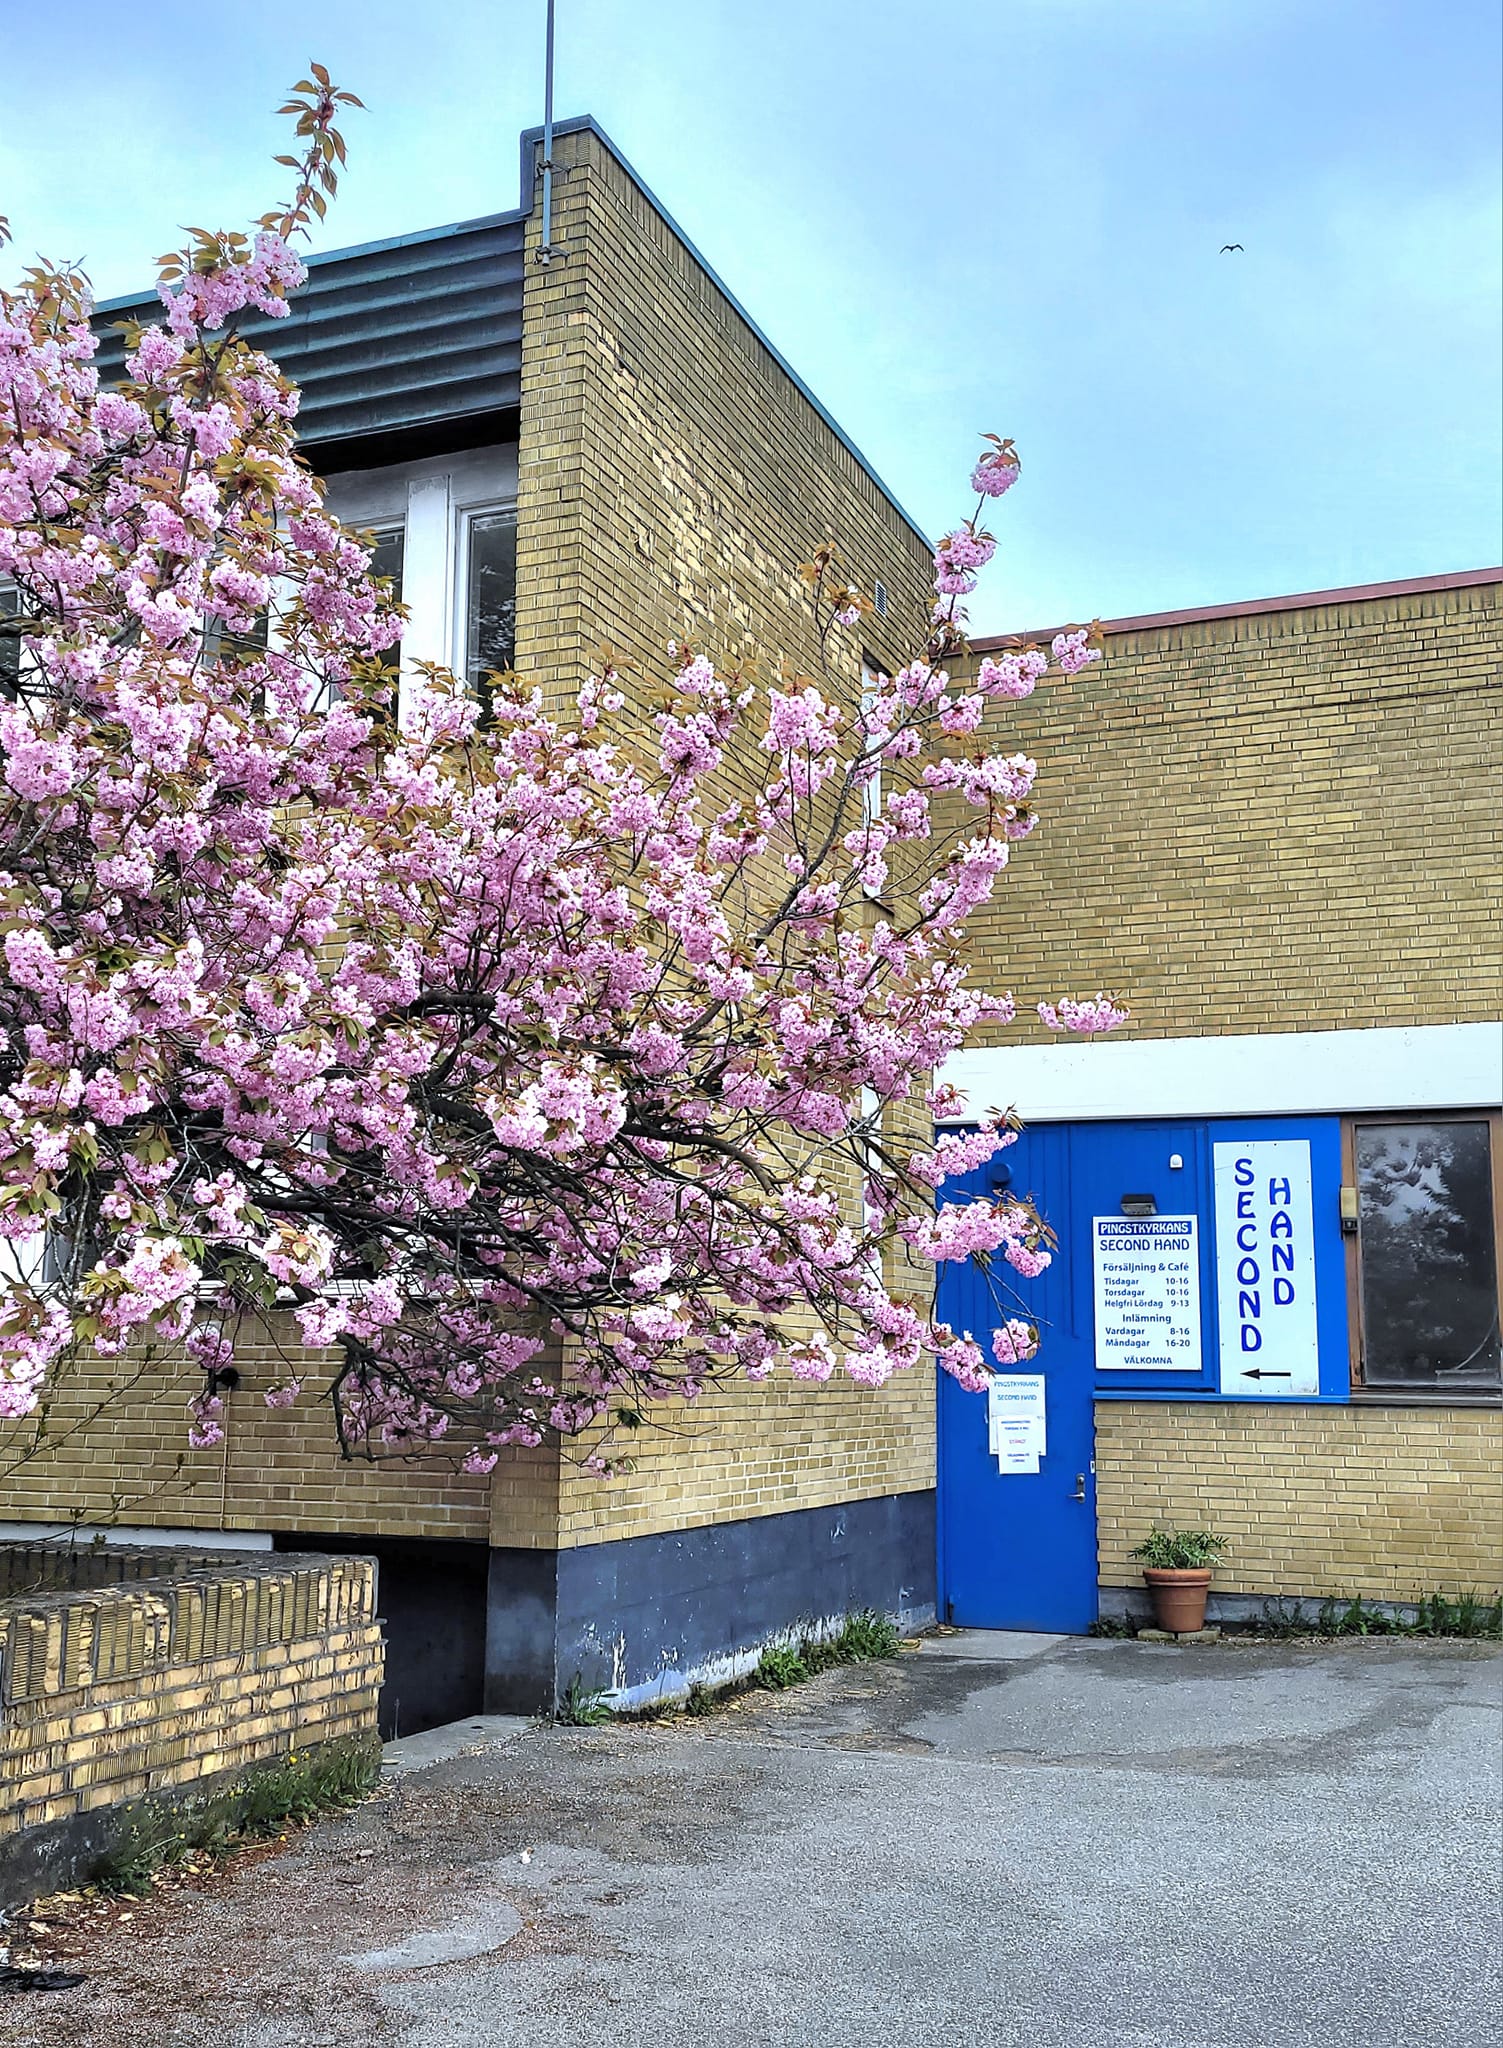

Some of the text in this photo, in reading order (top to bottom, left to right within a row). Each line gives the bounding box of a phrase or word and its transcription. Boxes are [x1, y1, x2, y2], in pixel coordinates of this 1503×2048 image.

[1100, 1222, 1189, 1235] PINGSTKYRKANS
[1100, 1238, 1190, 1251] SECOND HAND
[1269, 1177, 1295, 1306] HAND
[1234, 1158, 1262, 1352] SECOND
[1103, 1261, 1190, 1273] Försäljning & Café
[1104, 1277, 1189, 1286] Tisdagar 10-16
[1104, 1288, 1190, 1297] Torsdagar 10-16
[1104, 1299, 1190, 1309] Helgfri Lördag 9-13
[1122, 1313, 1172, 1324] Inlämning
[1105, 1327, 1190, 1336] Vardagar 8-16
[1105, 1338, 1191, 1348] Måndagar 16-20
[1124, 1355, 1173, 1364] VÄLKOMNA
